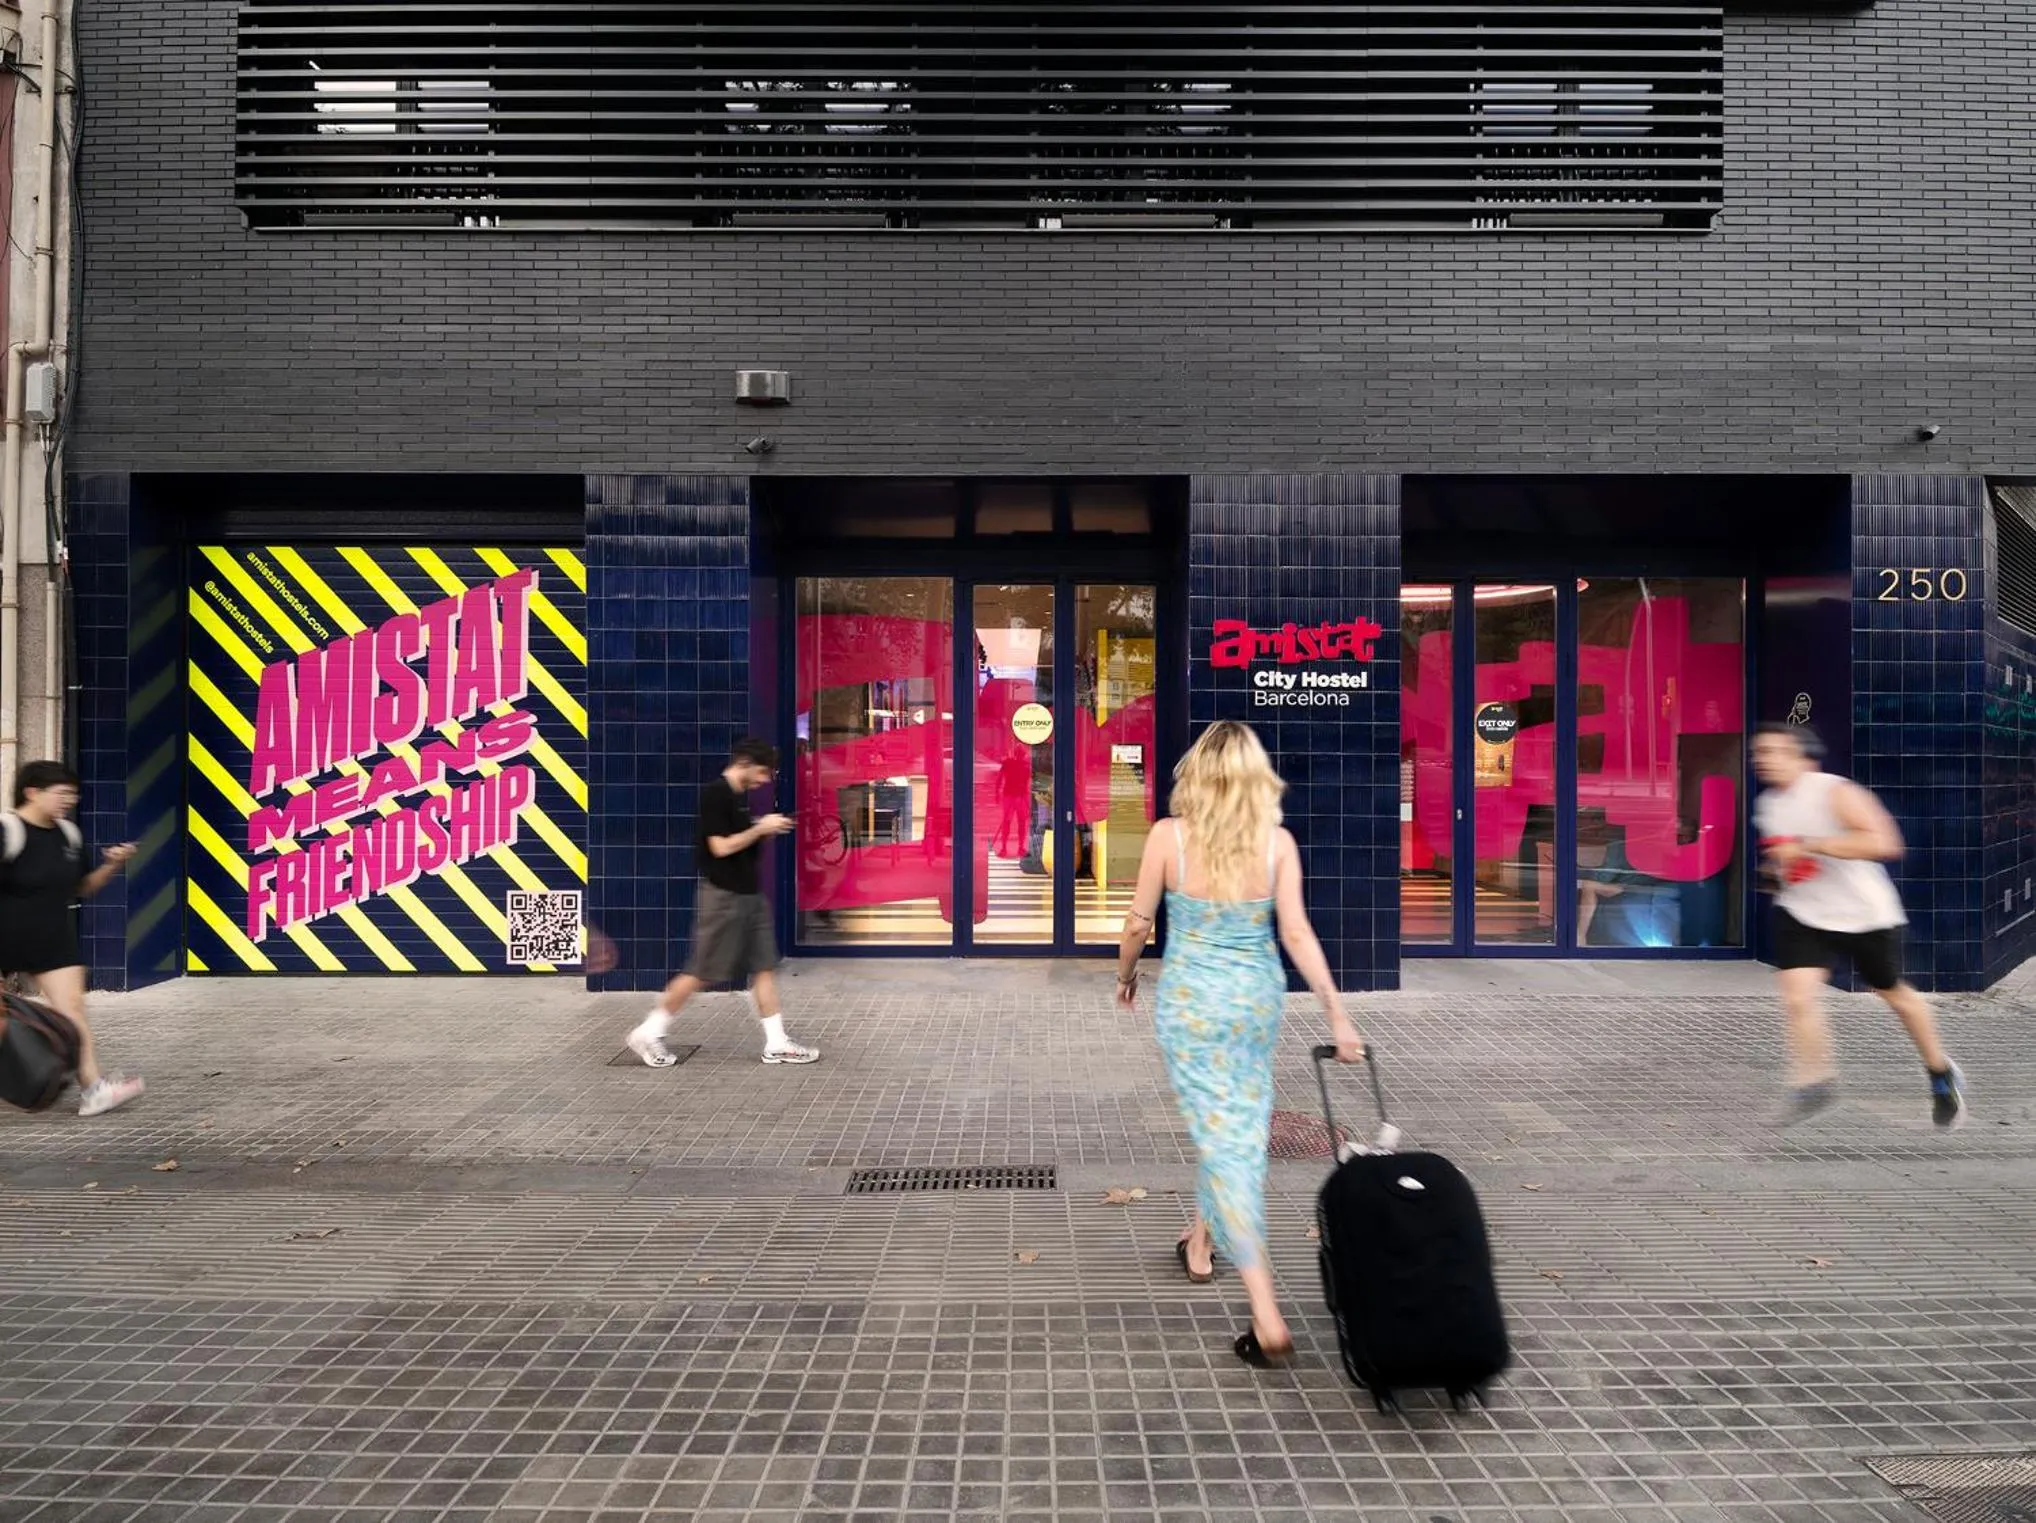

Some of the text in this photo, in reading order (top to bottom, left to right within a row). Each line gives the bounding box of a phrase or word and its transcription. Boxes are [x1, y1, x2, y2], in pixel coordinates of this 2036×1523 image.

[204, 581, 274, 653] @amistathostels
[247, 552, 329, 640] amistathostels.com
[1878, 568, 1967, 600] 250
[1210, 616, 1382, 669] amistat
[250, 566, 539, 798] AMISTAT
[1254, 671, 1368, 689] City Hostel
[1254, 690, 1350, 706] Barcelona
[247, 709, 538, 855] MEANS
[247, 764, 535, 944] FRIENDSHIP
